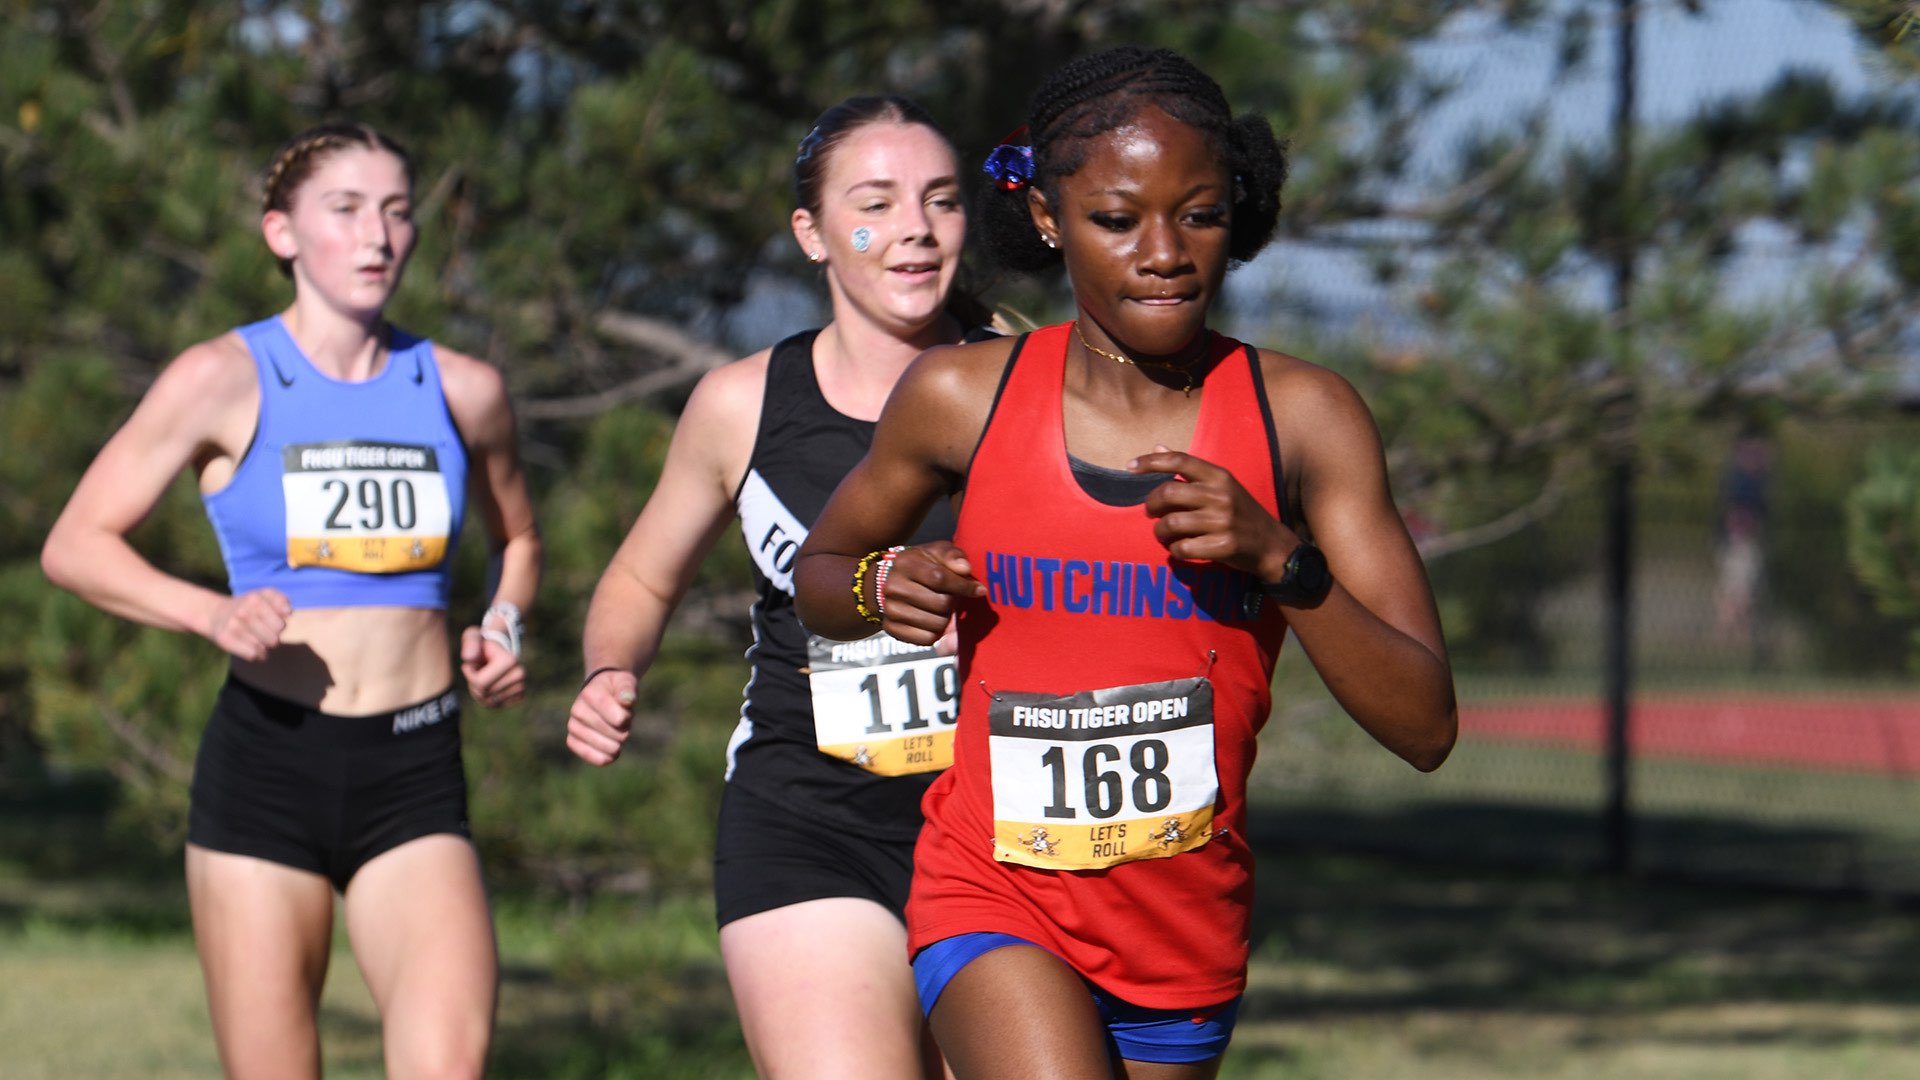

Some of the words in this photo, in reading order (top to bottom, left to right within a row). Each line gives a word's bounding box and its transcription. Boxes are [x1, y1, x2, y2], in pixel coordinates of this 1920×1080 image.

[346, 446, 386, 467] TIGER
[387, 447, 426, 468] OPEN
[322, 479, 416, 530] 290
[832, 638, 880, 662] FHSU
[880, 636, 932, 656] TIG
[860, 663, 960, 734] 119
[392, 700, 441, 735] NIKE
[1013, 706, 1066, 729] FHSU
[1069, 705, 1129, 729] TIGER
[1132, 697, 1188, 724] OPEN
[903, 735, 933, 750] LET'S
[906, 751, 933, 764] ROLL
[1041, 739, 1171, 819] 168
[1089, 824, 1127, 841] LET'S
[1092, 842, 1127, 858] ROLL
